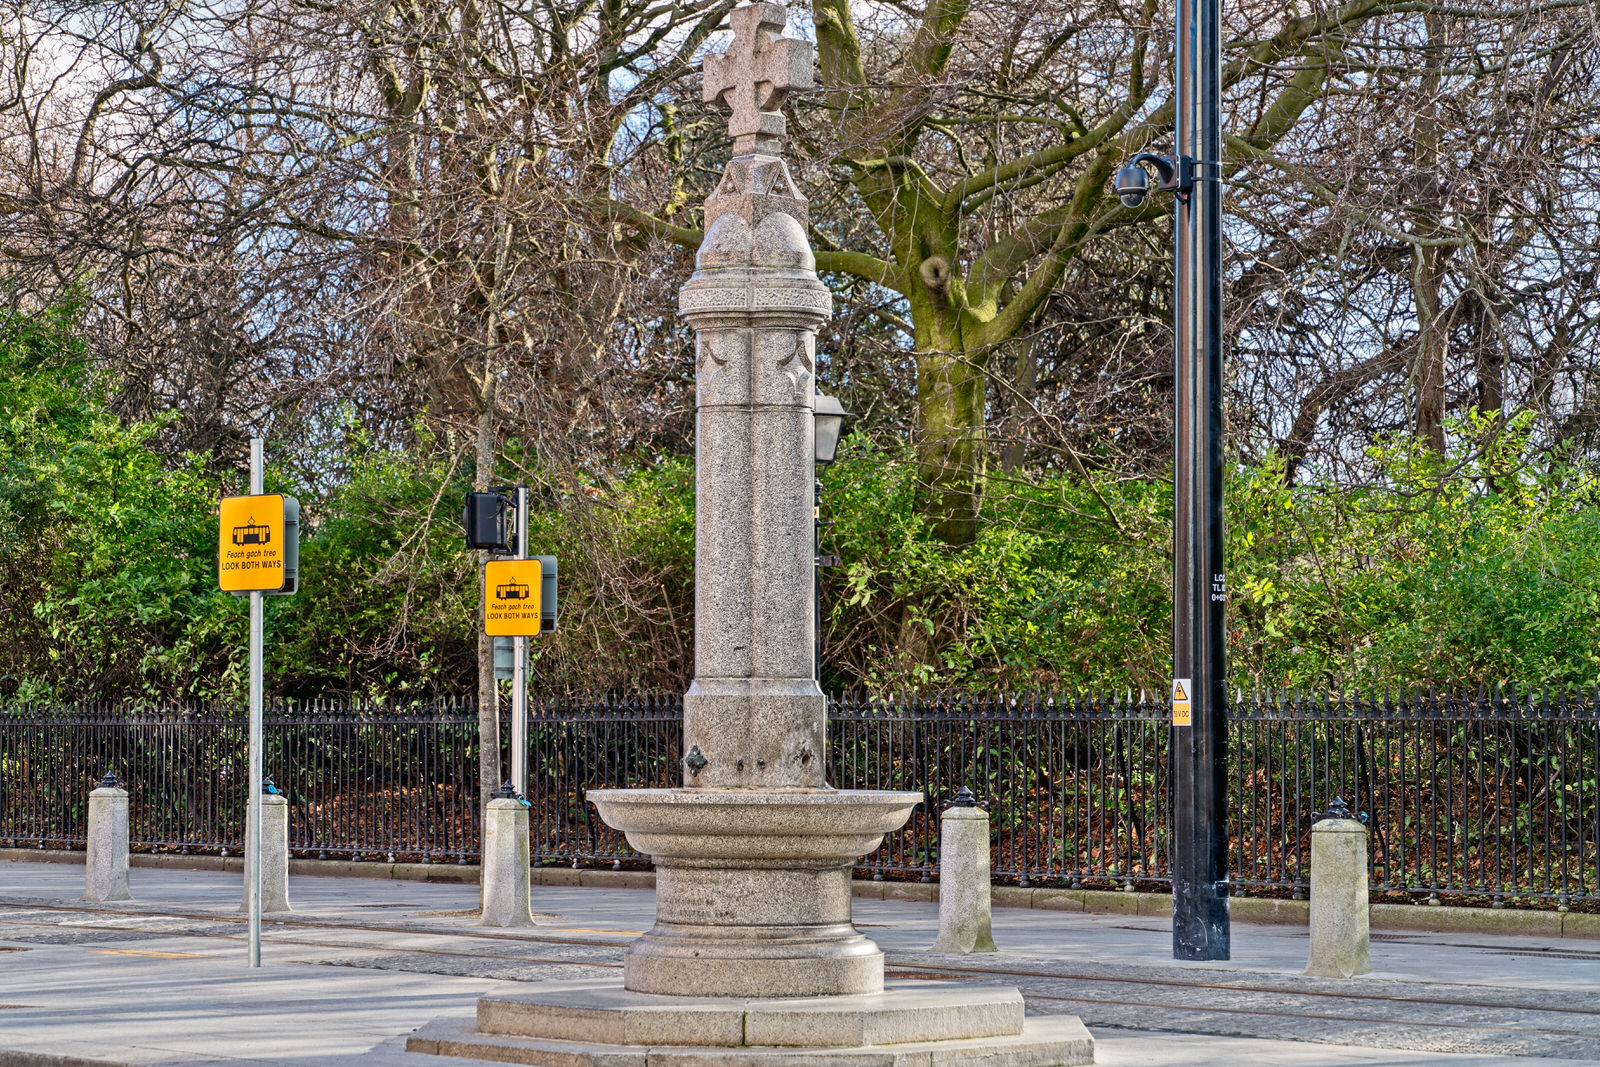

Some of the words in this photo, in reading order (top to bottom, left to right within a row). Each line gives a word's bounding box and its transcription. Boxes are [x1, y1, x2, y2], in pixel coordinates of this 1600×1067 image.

[246, 550, 261, 559] gach
[222, 562, 240, 570] LOOK
[242, 561, 260, 570] BOTH
[262, 560, 281, 568] WAYS
